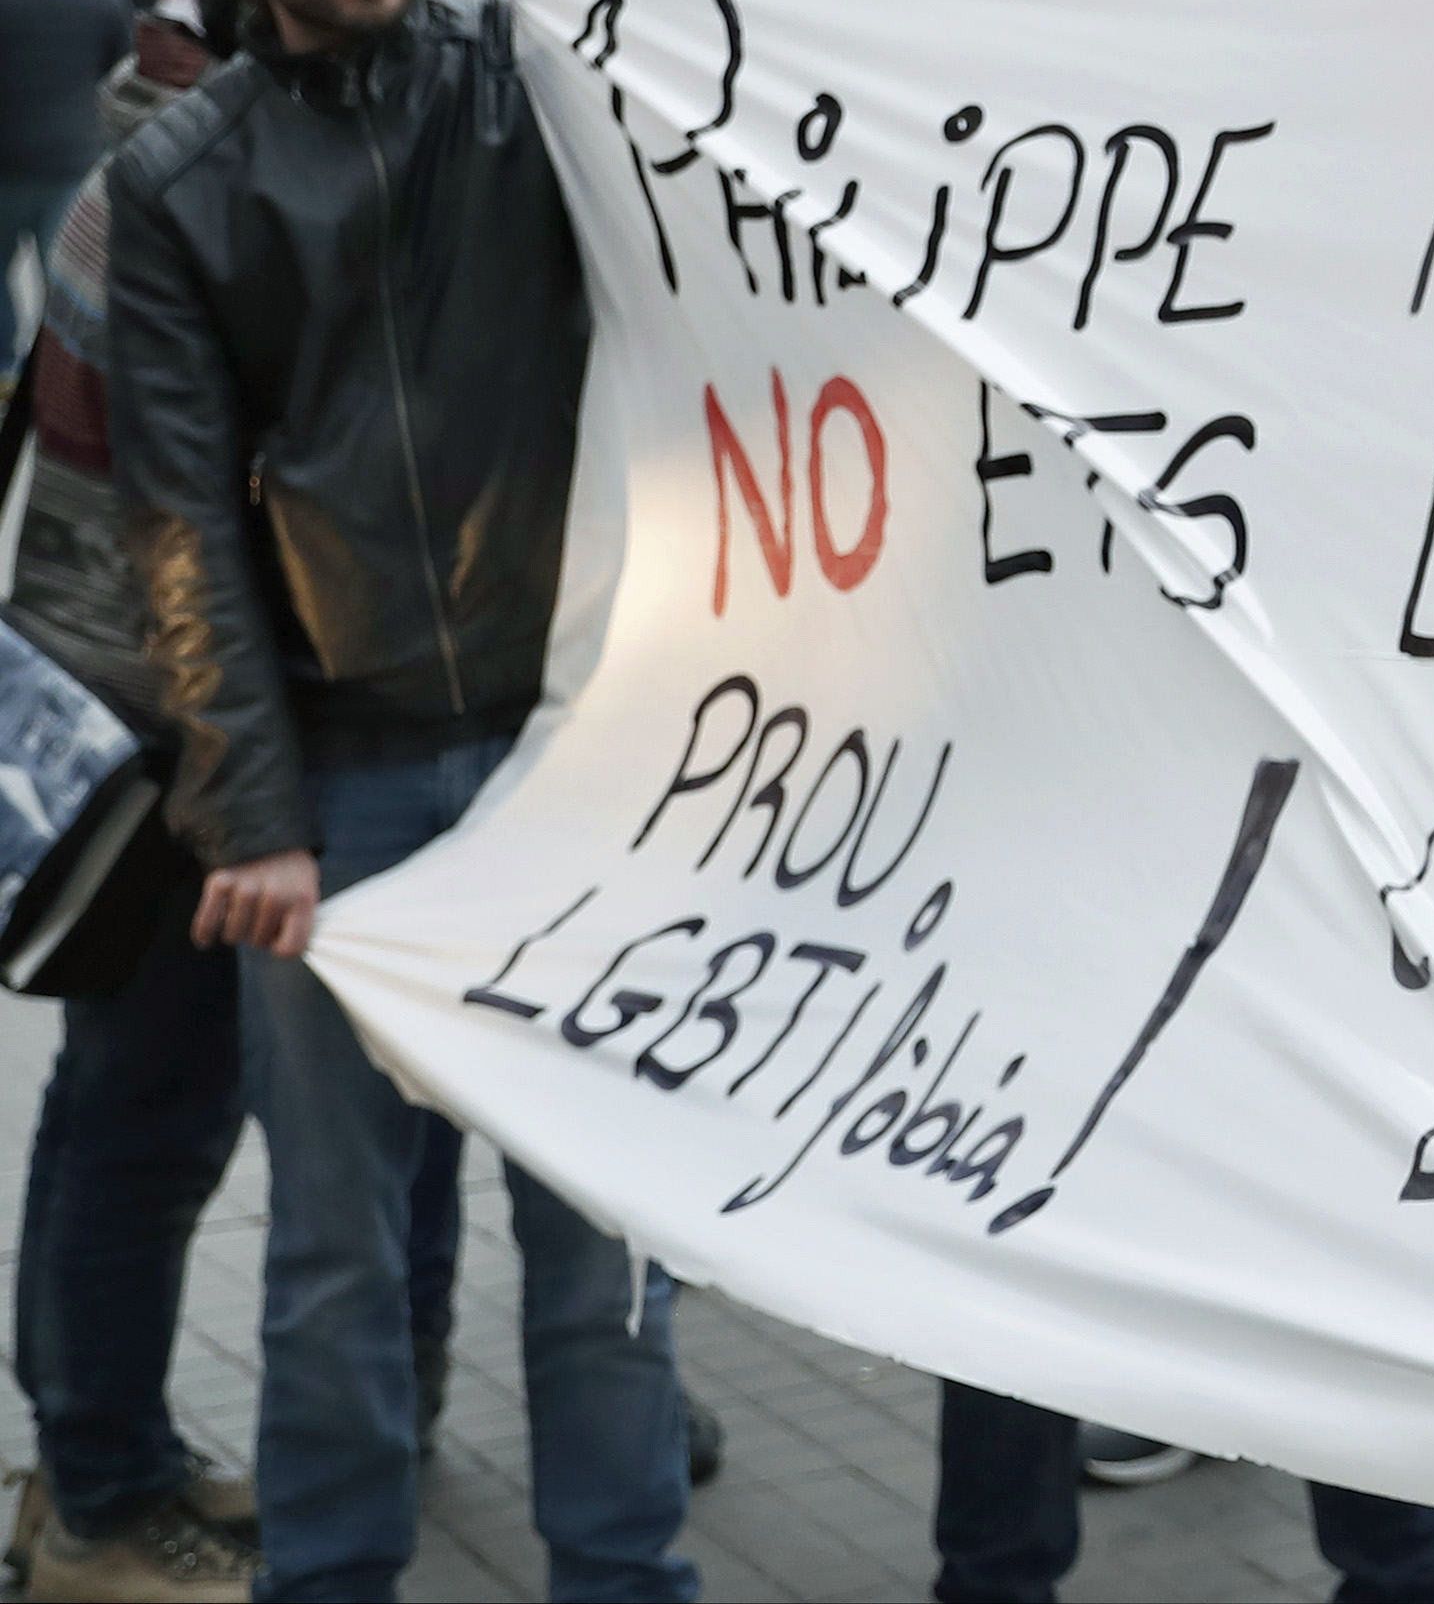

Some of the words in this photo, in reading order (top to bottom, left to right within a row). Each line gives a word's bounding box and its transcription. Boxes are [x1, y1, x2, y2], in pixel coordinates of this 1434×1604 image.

[703, 365, 890, 620] NO
[976, 378, 1256, 610] ETS
[631, 672, 954, 908] PROU
